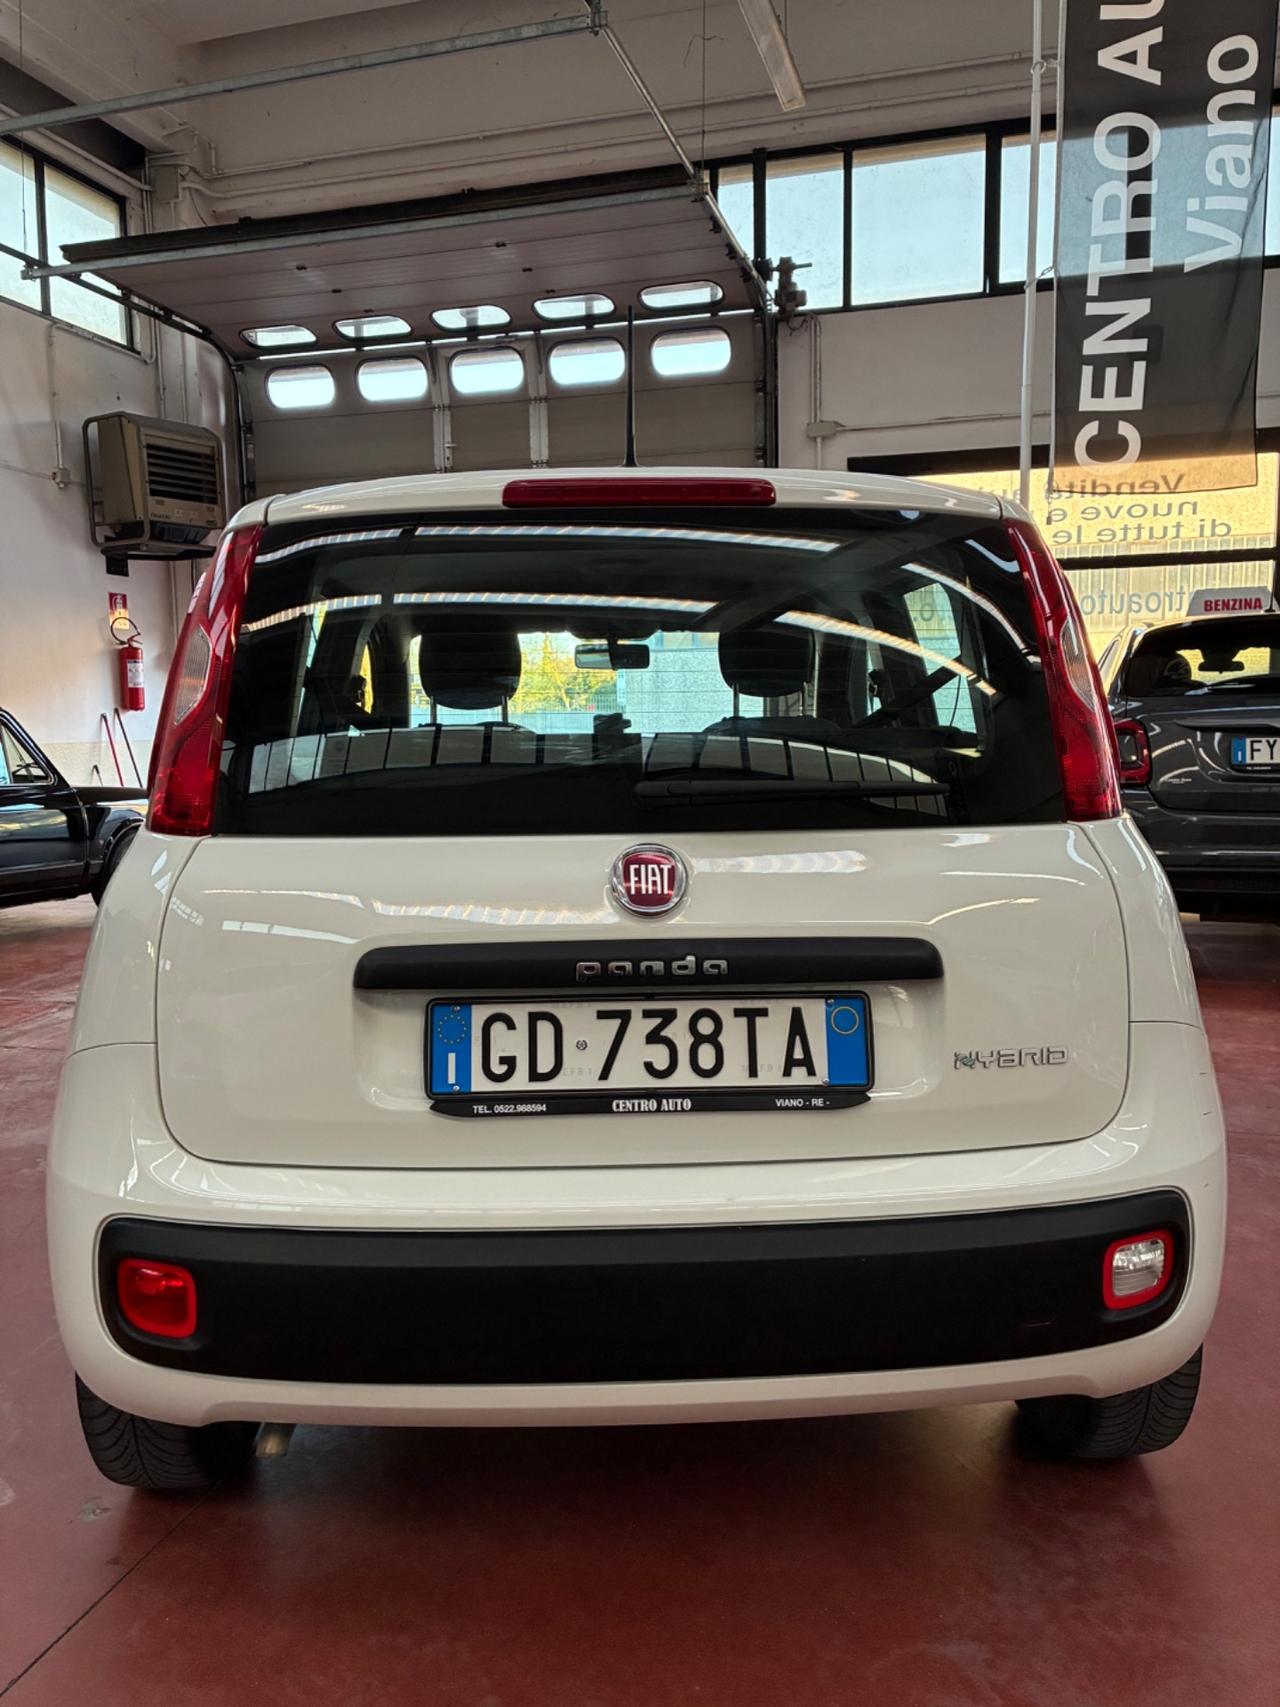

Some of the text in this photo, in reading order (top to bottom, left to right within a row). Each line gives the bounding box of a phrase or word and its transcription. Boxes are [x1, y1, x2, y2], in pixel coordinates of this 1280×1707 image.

[1184, 34, 1259, 272] Viano
[1074, 111, 1162, 476] CENTRO
[1203, 597, 1263, 612] BENZINA
[1250, 739, 1277, 761] FY
[629, 863, 674, 895] FIAT
[575, 954, 728, 983] panda
[481, 1012, 564, 1083] GD
[596, 1007, 817, 1081] 738TA
[954, 1045, 1069, 1070] HYBRID
[472, 1105, 492, 1114] TEL.
[612, 1098, 692, 1112] CENTRO AUTO
[775, 1098, 804, 1107] VIANO
[811, 1098, 825, 1107] RE
